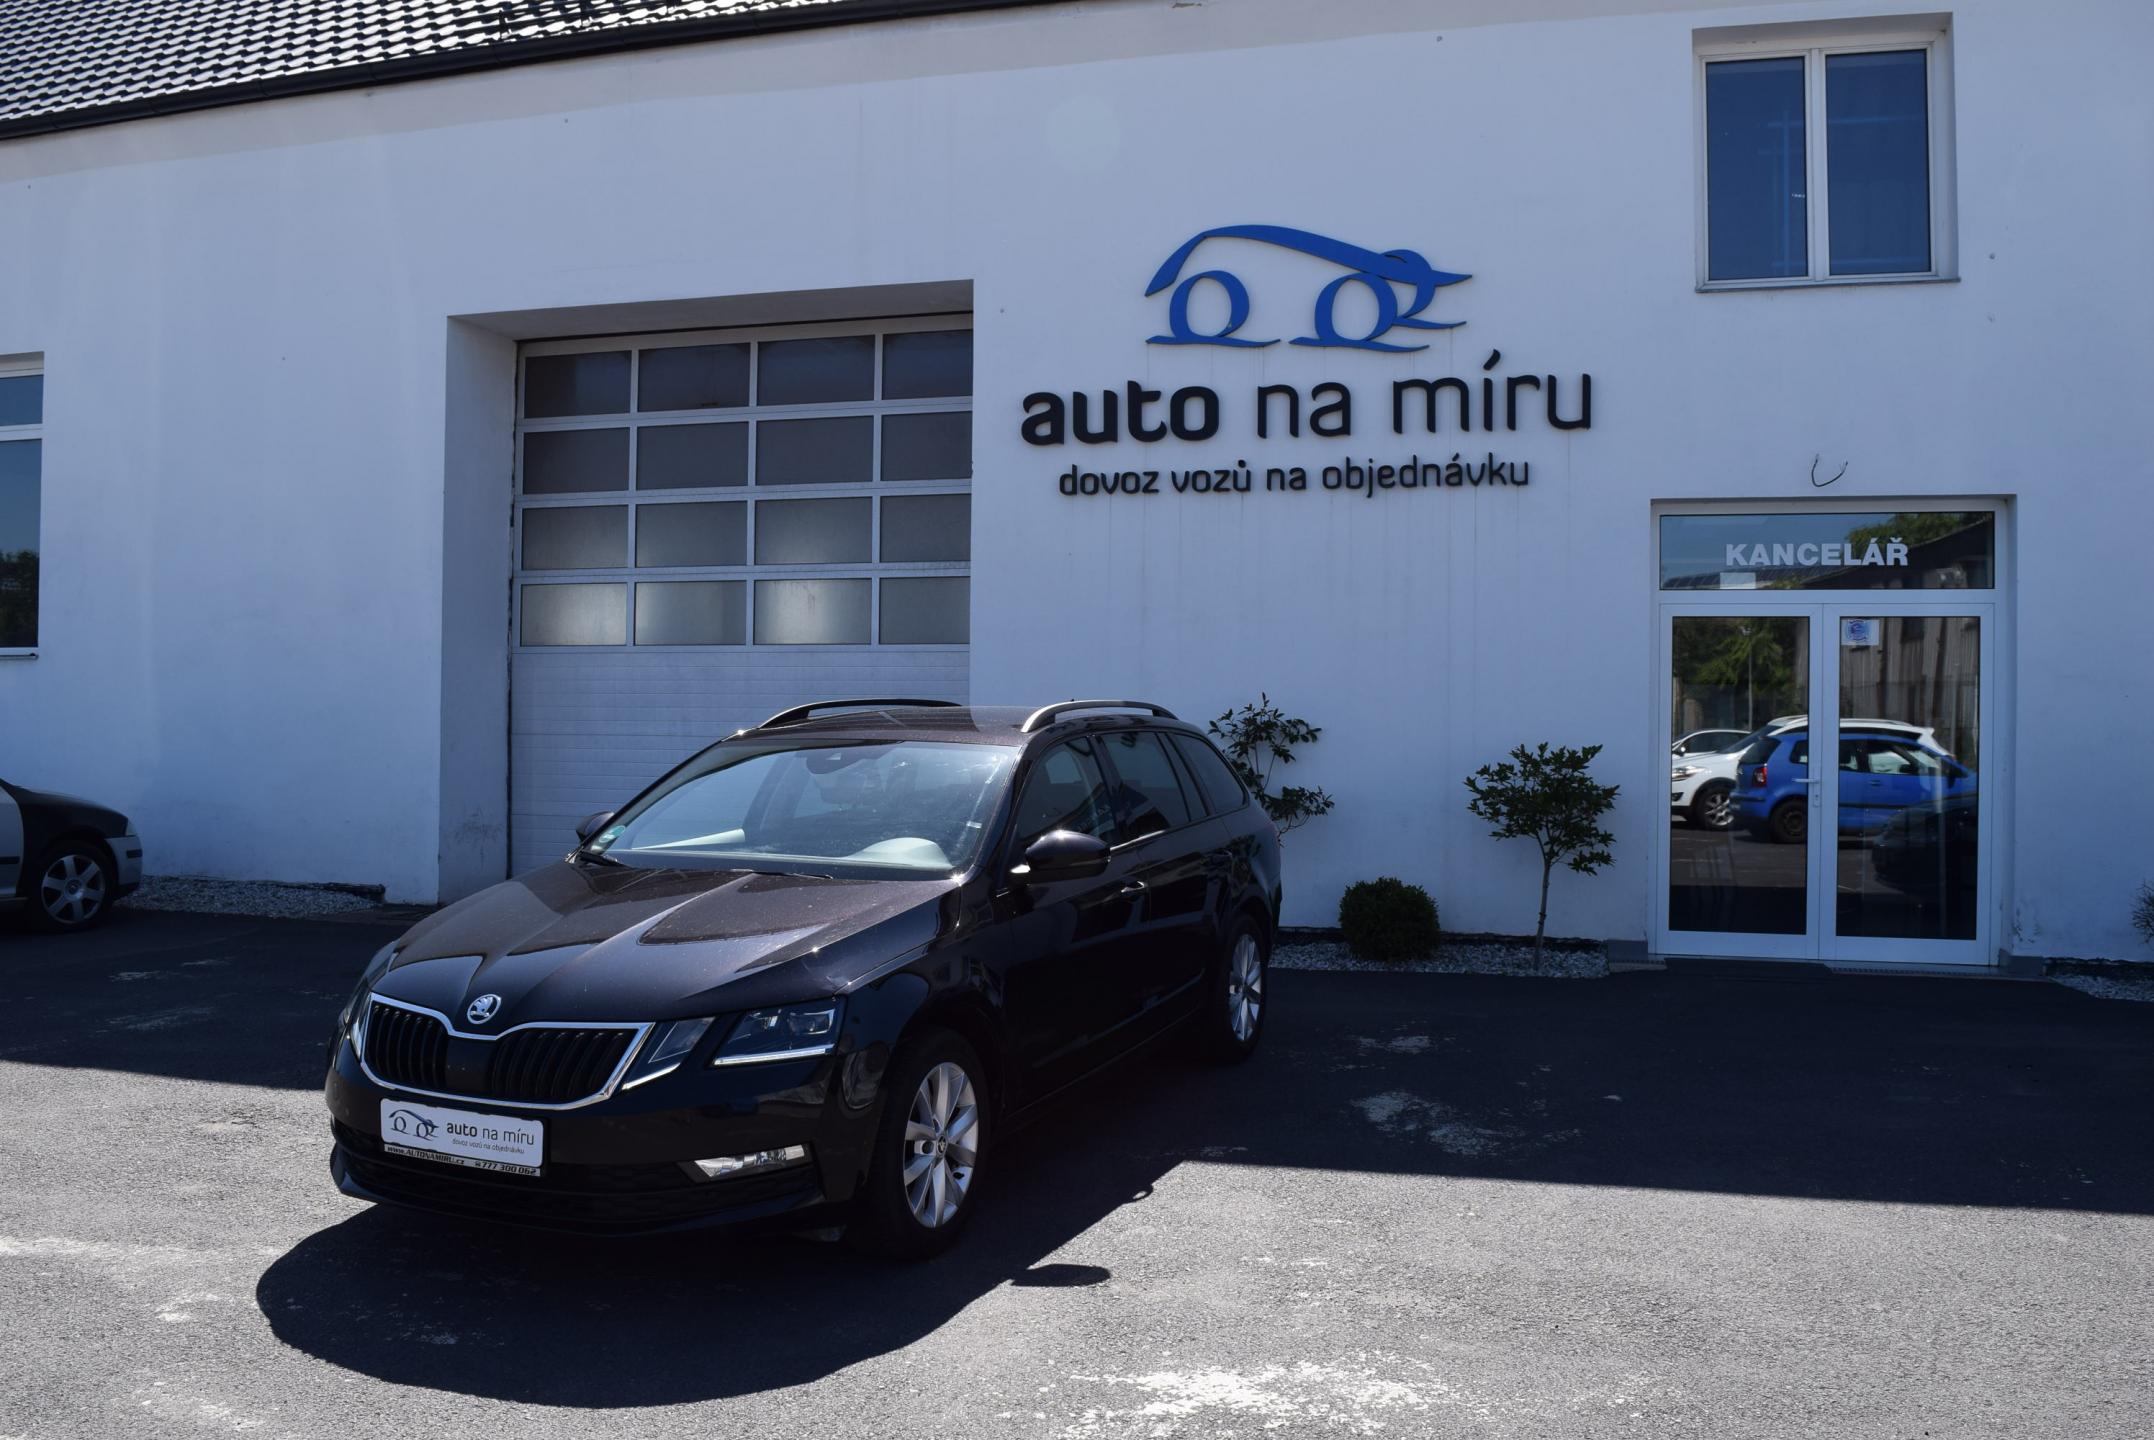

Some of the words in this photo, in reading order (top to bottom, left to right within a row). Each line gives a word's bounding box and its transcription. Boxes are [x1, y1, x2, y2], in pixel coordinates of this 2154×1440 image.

[1021, 381, 1219, 446] auto
[1257, 382, 1351, 439] na
[1393, 349, 1591, 434] míru
[1059, 464, 1160, 497] dovoz
[1171, 459, 1252, 494] vozů
[1266, 468, 1307, 492] na
[1322, 452, 1528, 498] objednávku
[1726, 537, 1908, 566] KANCELÁŘ
[446, 1122, 478, 1137] auto
[482, 1128, 498, 1140] na
[503, 1128, 534, 1145] míru
[481, 1161, 498, 1170] 777
